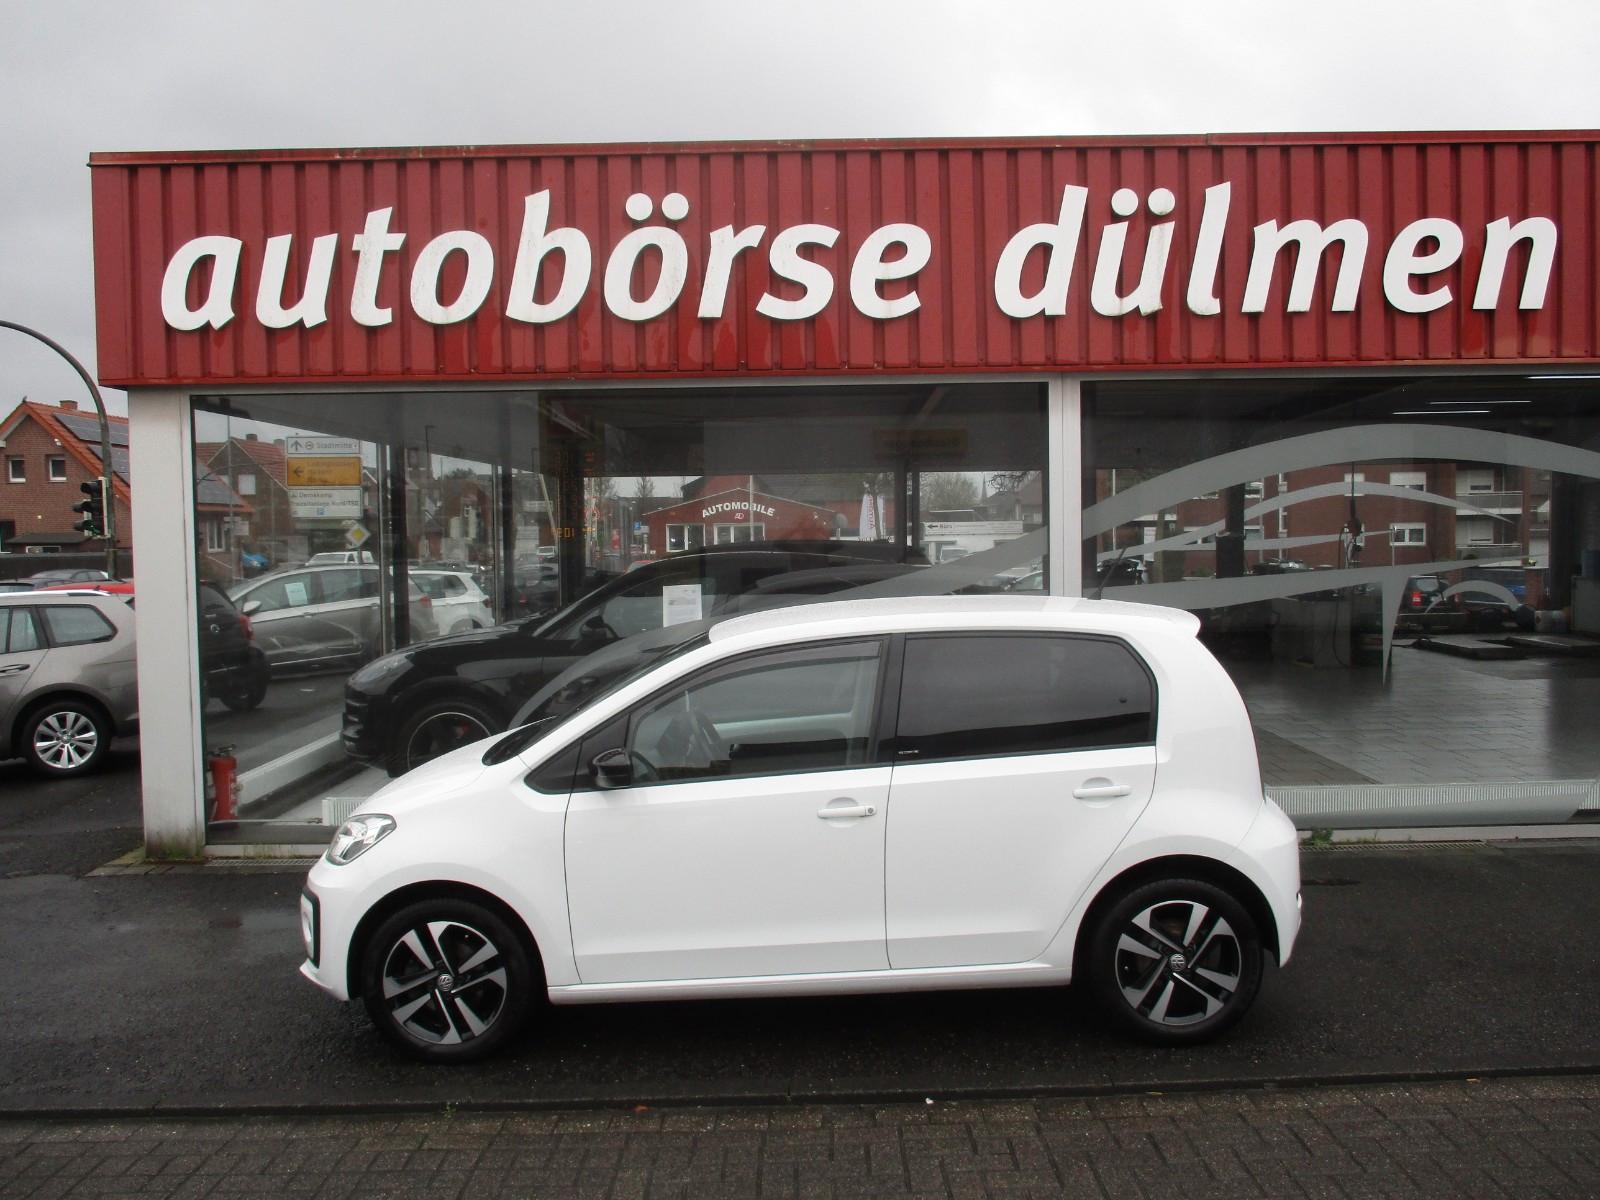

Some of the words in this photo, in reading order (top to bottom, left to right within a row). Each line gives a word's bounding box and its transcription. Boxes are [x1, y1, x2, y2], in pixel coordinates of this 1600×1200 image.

[160, 188, 932, 331] autobörse
[994, 181, 1558, 319] dülmen
[702, 501, 776, 518] AUTOMOBILE
